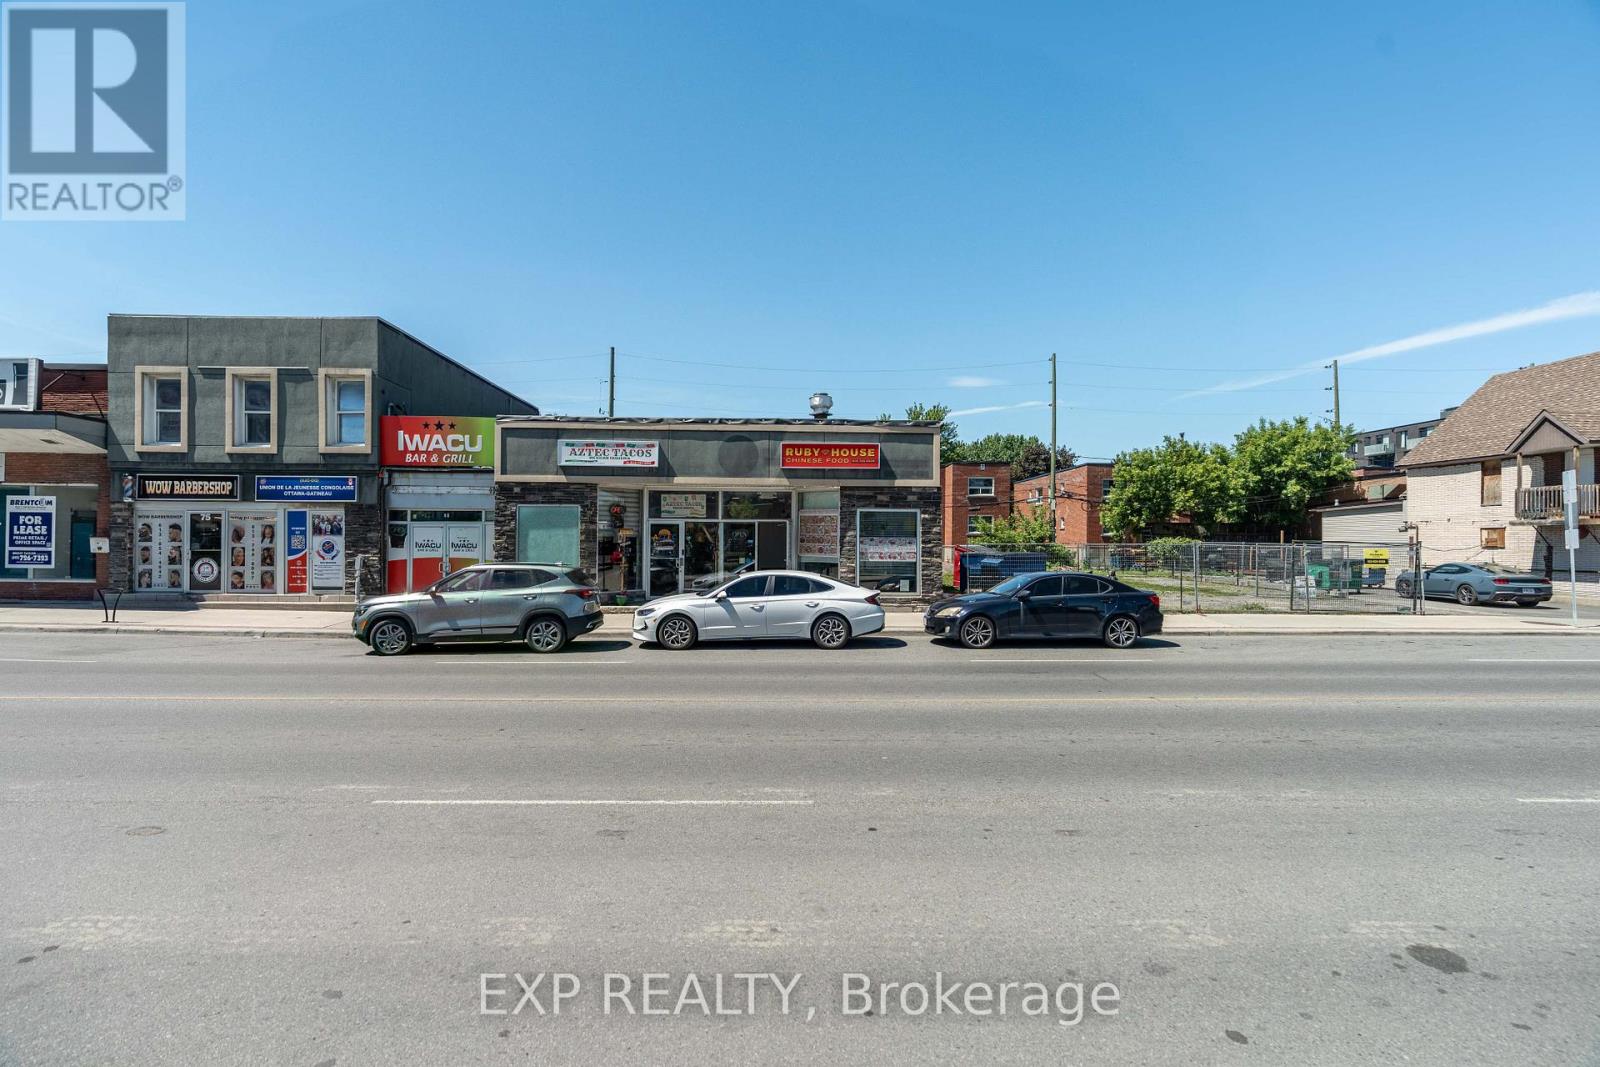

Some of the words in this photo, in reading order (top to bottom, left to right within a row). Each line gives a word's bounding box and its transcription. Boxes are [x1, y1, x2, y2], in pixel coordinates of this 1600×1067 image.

[397, 430, 483, 452] IWACU
[569, 448, 610, 457] AZTEC
[612, 448, 652, 458] TACOS
[785, 447, 821, 457] RUBY
[831, 448, 875, 457] HOUSE
[405, 453, 427, 463] BAR
[430, 453, 440, 463] &
[442, 453, 475, 464] GRILL
[145, 480, 172, 494] WOW
[173, 480, 233, 495] BARBERSHOP
[19, 515, 43, 525] FOR
[13, 525, 48, 535] LEASE
[415, 541, 442, 549] IWACU
[451, 541, 478, 549] IWACU
